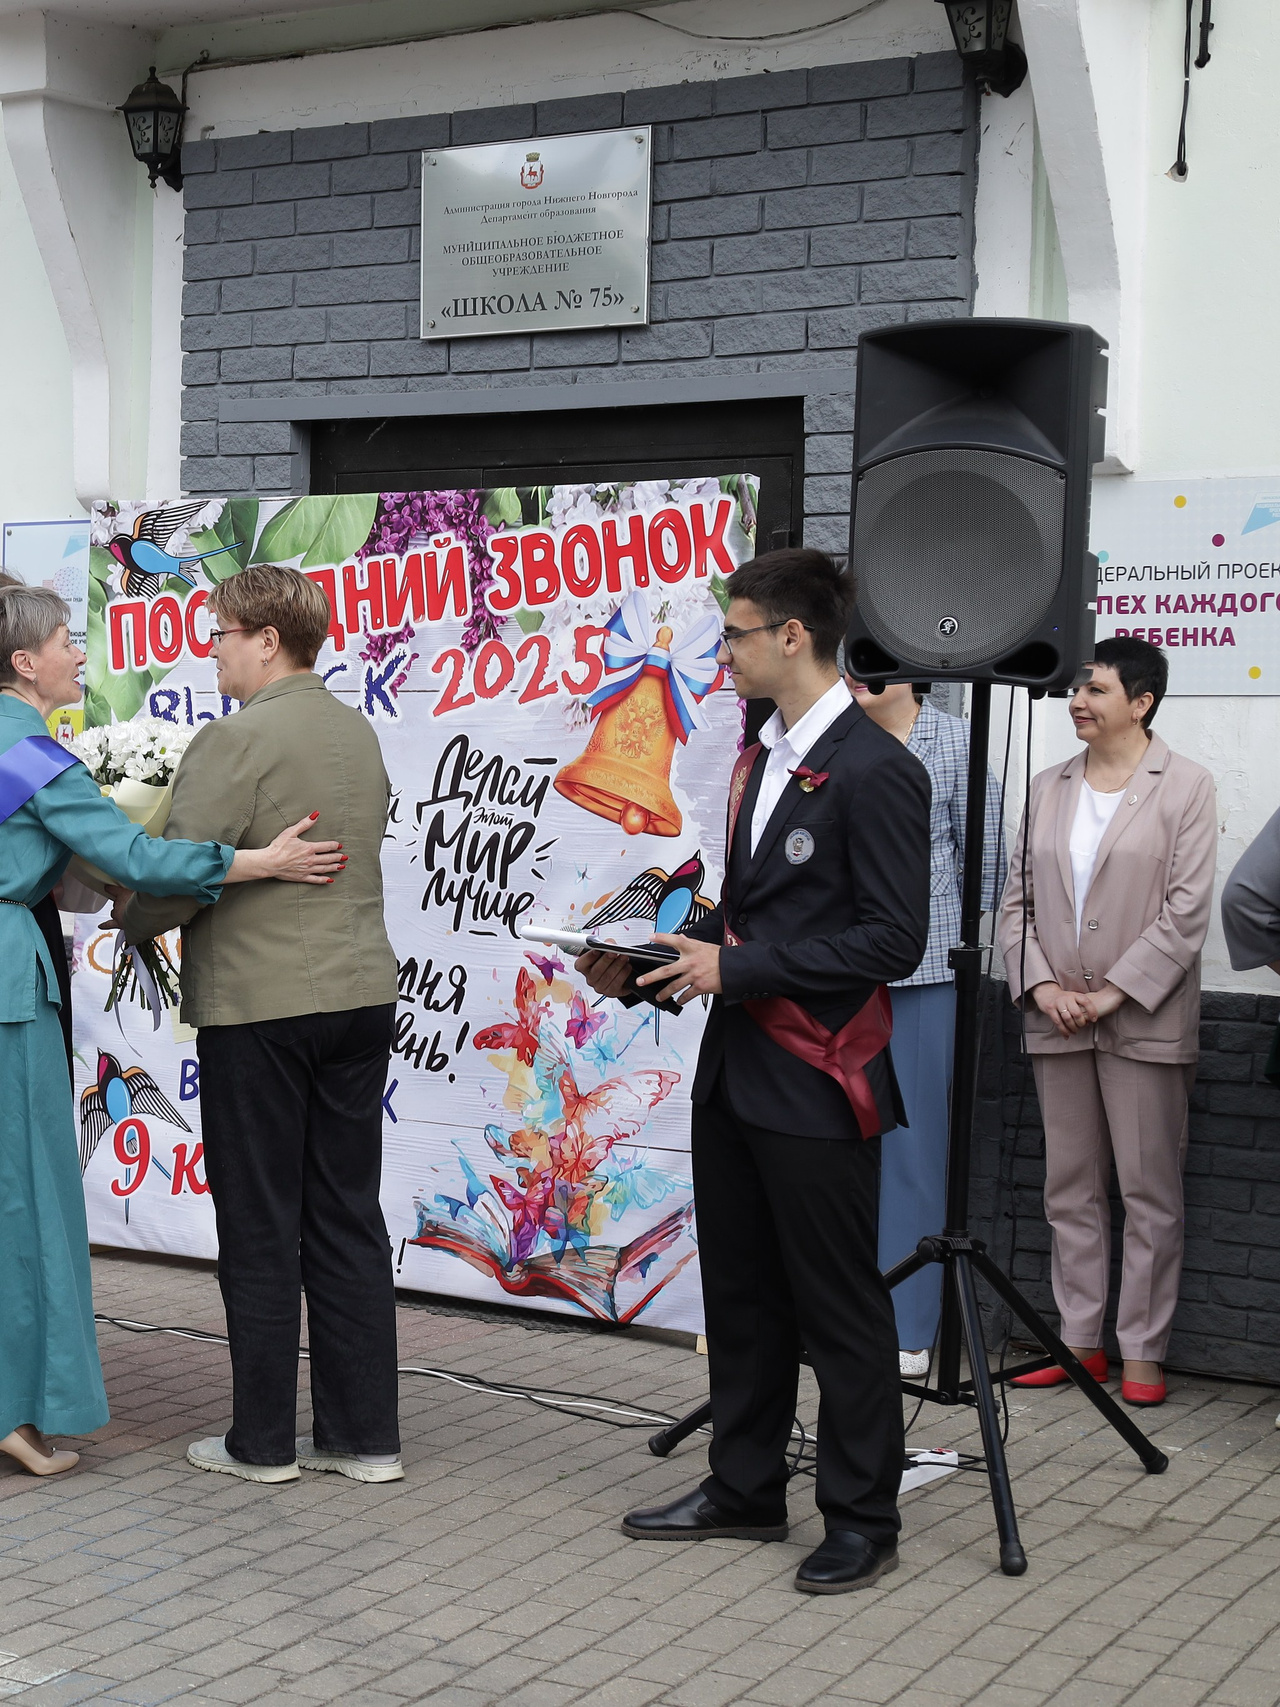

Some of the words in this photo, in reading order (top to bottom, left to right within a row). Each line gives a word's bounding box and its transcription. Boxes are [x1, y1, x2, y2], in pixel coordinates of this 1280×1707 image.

[443, 202, 510, 215] Администрация
[512, 199, 541, 210] города
[544, 195, 586, 205] Нижнего
[588, 190, 638, 200] Новгорода
[480, 212, 538, 224] Департамент
[539, 207, 596, 219] образования
[443, 236, 544, 254] МУНИЦИПАЛЬНОЕ
[546, 230, 624, 245] БЮДЖЕТНОЕ
[461, 245, 602, 266] ОБЩЕОБРАЗОВАТЕЛЬНОЕ
[492, 262, 570, 277] УЧРЕЖДЕНИЕ
[441, 291, 547, 318] «ШКОЛА
[554, 289, 583, 310] №
[590, 286, 625, 308] 75»
[488, 500, 735, 610] ЗВОНОК
[1217, 562, 1280, 580] ПРОЕК
[1097, 594, 1147, 615] ПЕХ
[1155, 592, 1280, 617] КАЖДОГ
[431, 625, 610, 717] 2025
[424, 809, 536, 890] Мир
[389, 1012, 470, 1083] ень!
